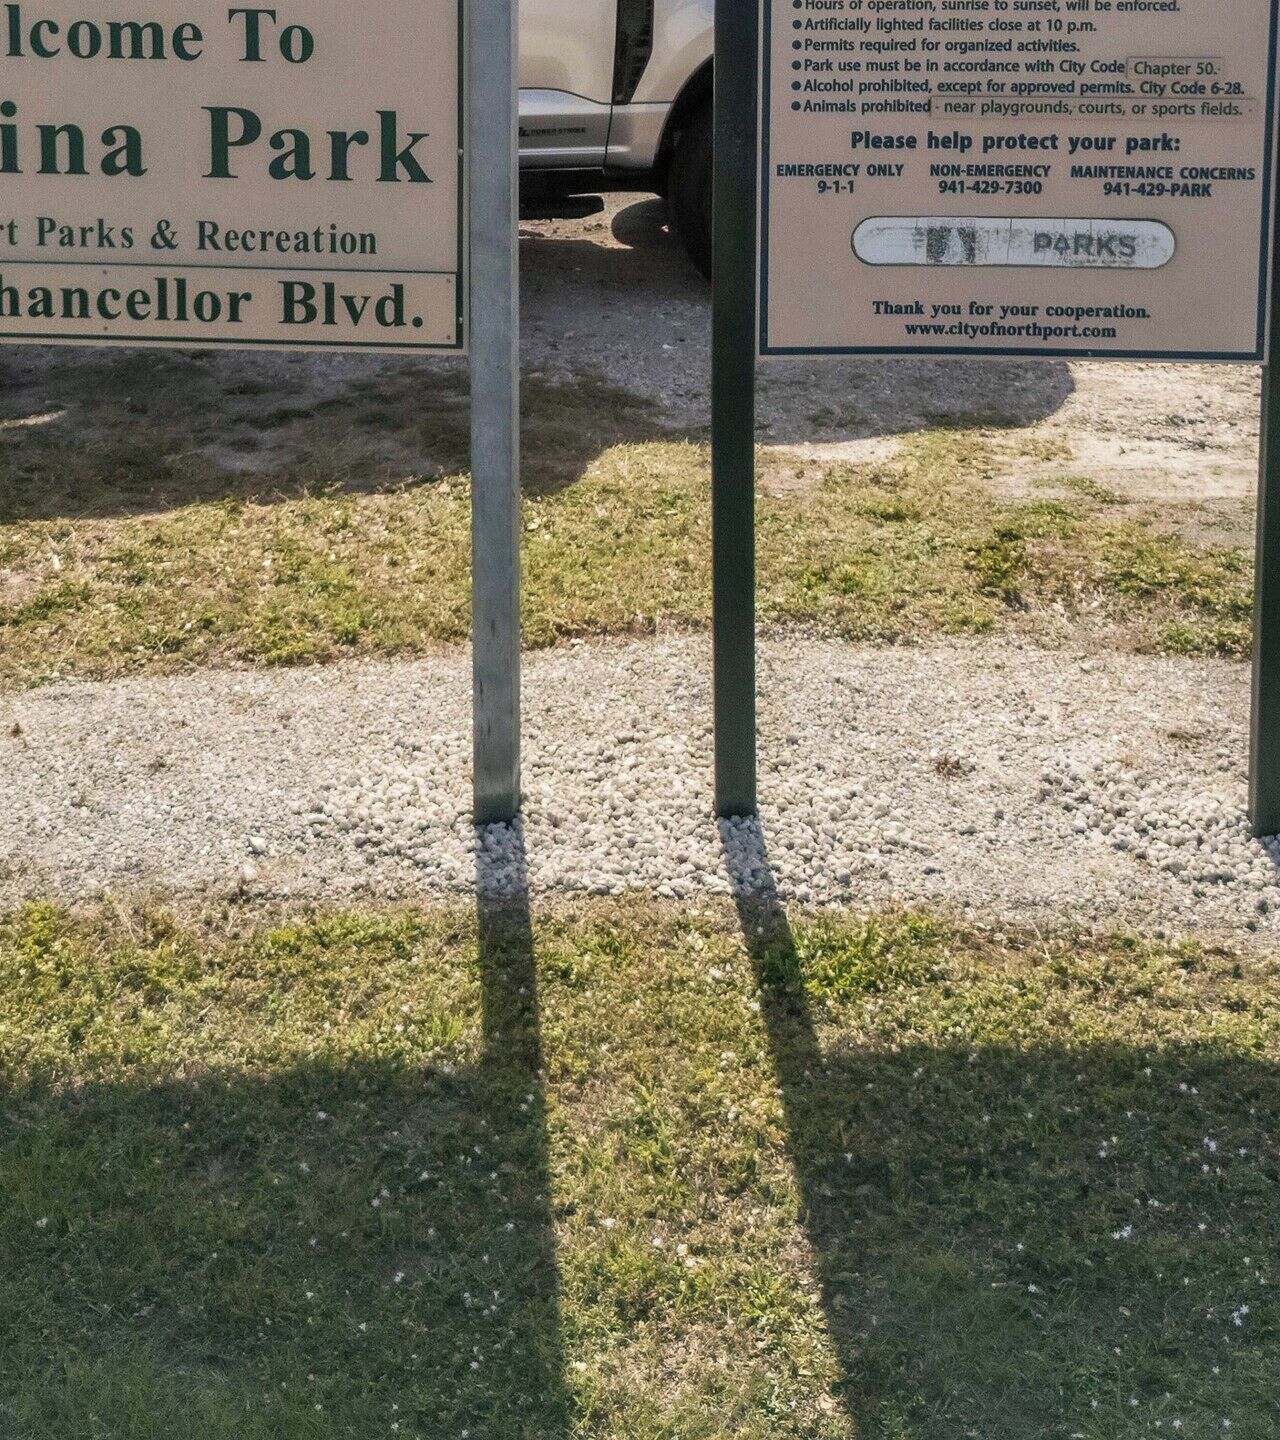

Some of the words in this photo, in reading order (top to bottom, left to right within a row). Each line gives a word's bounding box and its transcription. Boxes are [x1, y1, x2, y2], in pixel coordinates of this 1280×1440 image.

[227, 7, 314, 64] To
[803, 16, 872, 34] Artificially
[875, 16, 924, 34] lighted
[927, 16, 984, 32] facilities
[987, 16, 1023, 32] close
[1026, 19, 1041, 32] at
[1045, 17, 1063, 32] 10
[1065, 20, 1097, 35] p.m.
[803, 37, 855, 51] Permits
[858, 37, 916, 55] required
[919, 36, 941, 52] for
[943, 37, 1013, 55] organized
[1015, 37, 1080, 53] activities.
[803, 57, 834, 72] Park
[837, 60, 861, 72] use
[864, 59, 900, 72] must
[902, 57, 922, 72] be
[925, 57, 939, 72] in
[942, 57, 1020, 73] accordance
[1023, 58, 1055, 73] with
[1058, 58, 1086, 76] City
[1089, 58, 1126, 74] Code
[1132, 60, 1192, 78] Chapter
[1195, 60, 1218, 76] 50.
[802, 77, 854, 92] Alcohol
[857, 77, 933, 96] prohibited,
[935, 79, 982, 96] except
[985, 77, 1006, 93] for
[1009, 78, 1075, 96] approved
[1079, 79, 1135, 96] permits.
[1138, 79, 1167, 97] City
[1169, 79, 1206, 95] Code
[1209, 80, 1245, 95] 6-28.
[802, 98, 857, 113] Animals
[860, 96, 932, 116] prohibited
[943, 101, 976, 113] near
[980, 98, 1073, 117] playgrounds,
[1077, 101, 1126, 116] courts,
[1130, 103, 1148, 115] or
[1150, 102, 1196, 118] sports
[1199, 100, 1243, 116] fields.
[199, 105, 434, 184] Park
[850, 129, 917, 149] Please
[926, 129, 973, 154] help
[981, 132, 1059, 154] protect
[1067, 135, 1117, 155] your
[1124, 131, 1181, 156] park:
[775, 162, 861, 177] EMERGENCY
[865, 162, 904, 177] ONLY
[928, 163, 1051, 178] NON-EMERGENCY
[1069, 164, 1173, 180] MAINTENANCE
[1178, 165, 1256, 181] CONCERNS
[816, 179, 855, 194] 9-1-1
[937, 179, 1043, 195] 941-429-7300
[1102, 180, 1212, 198] 941-429-PARK
[35, 215, 134, 249] Parks
[149, 218, 179, 250] &
[195, 219, 378, 255] Recreation
[276, 279, 424, 329] Blvd.
[871, 299, 925, 315] Thank
[929, 303, 962, 319] you
[967, 299, 994, 316] for
[998, 304, 1040, 320] your
[1044, 302, 1151, 322] cooperation.
[903, 320, 1117, 341] www.cityofnorthport.com
